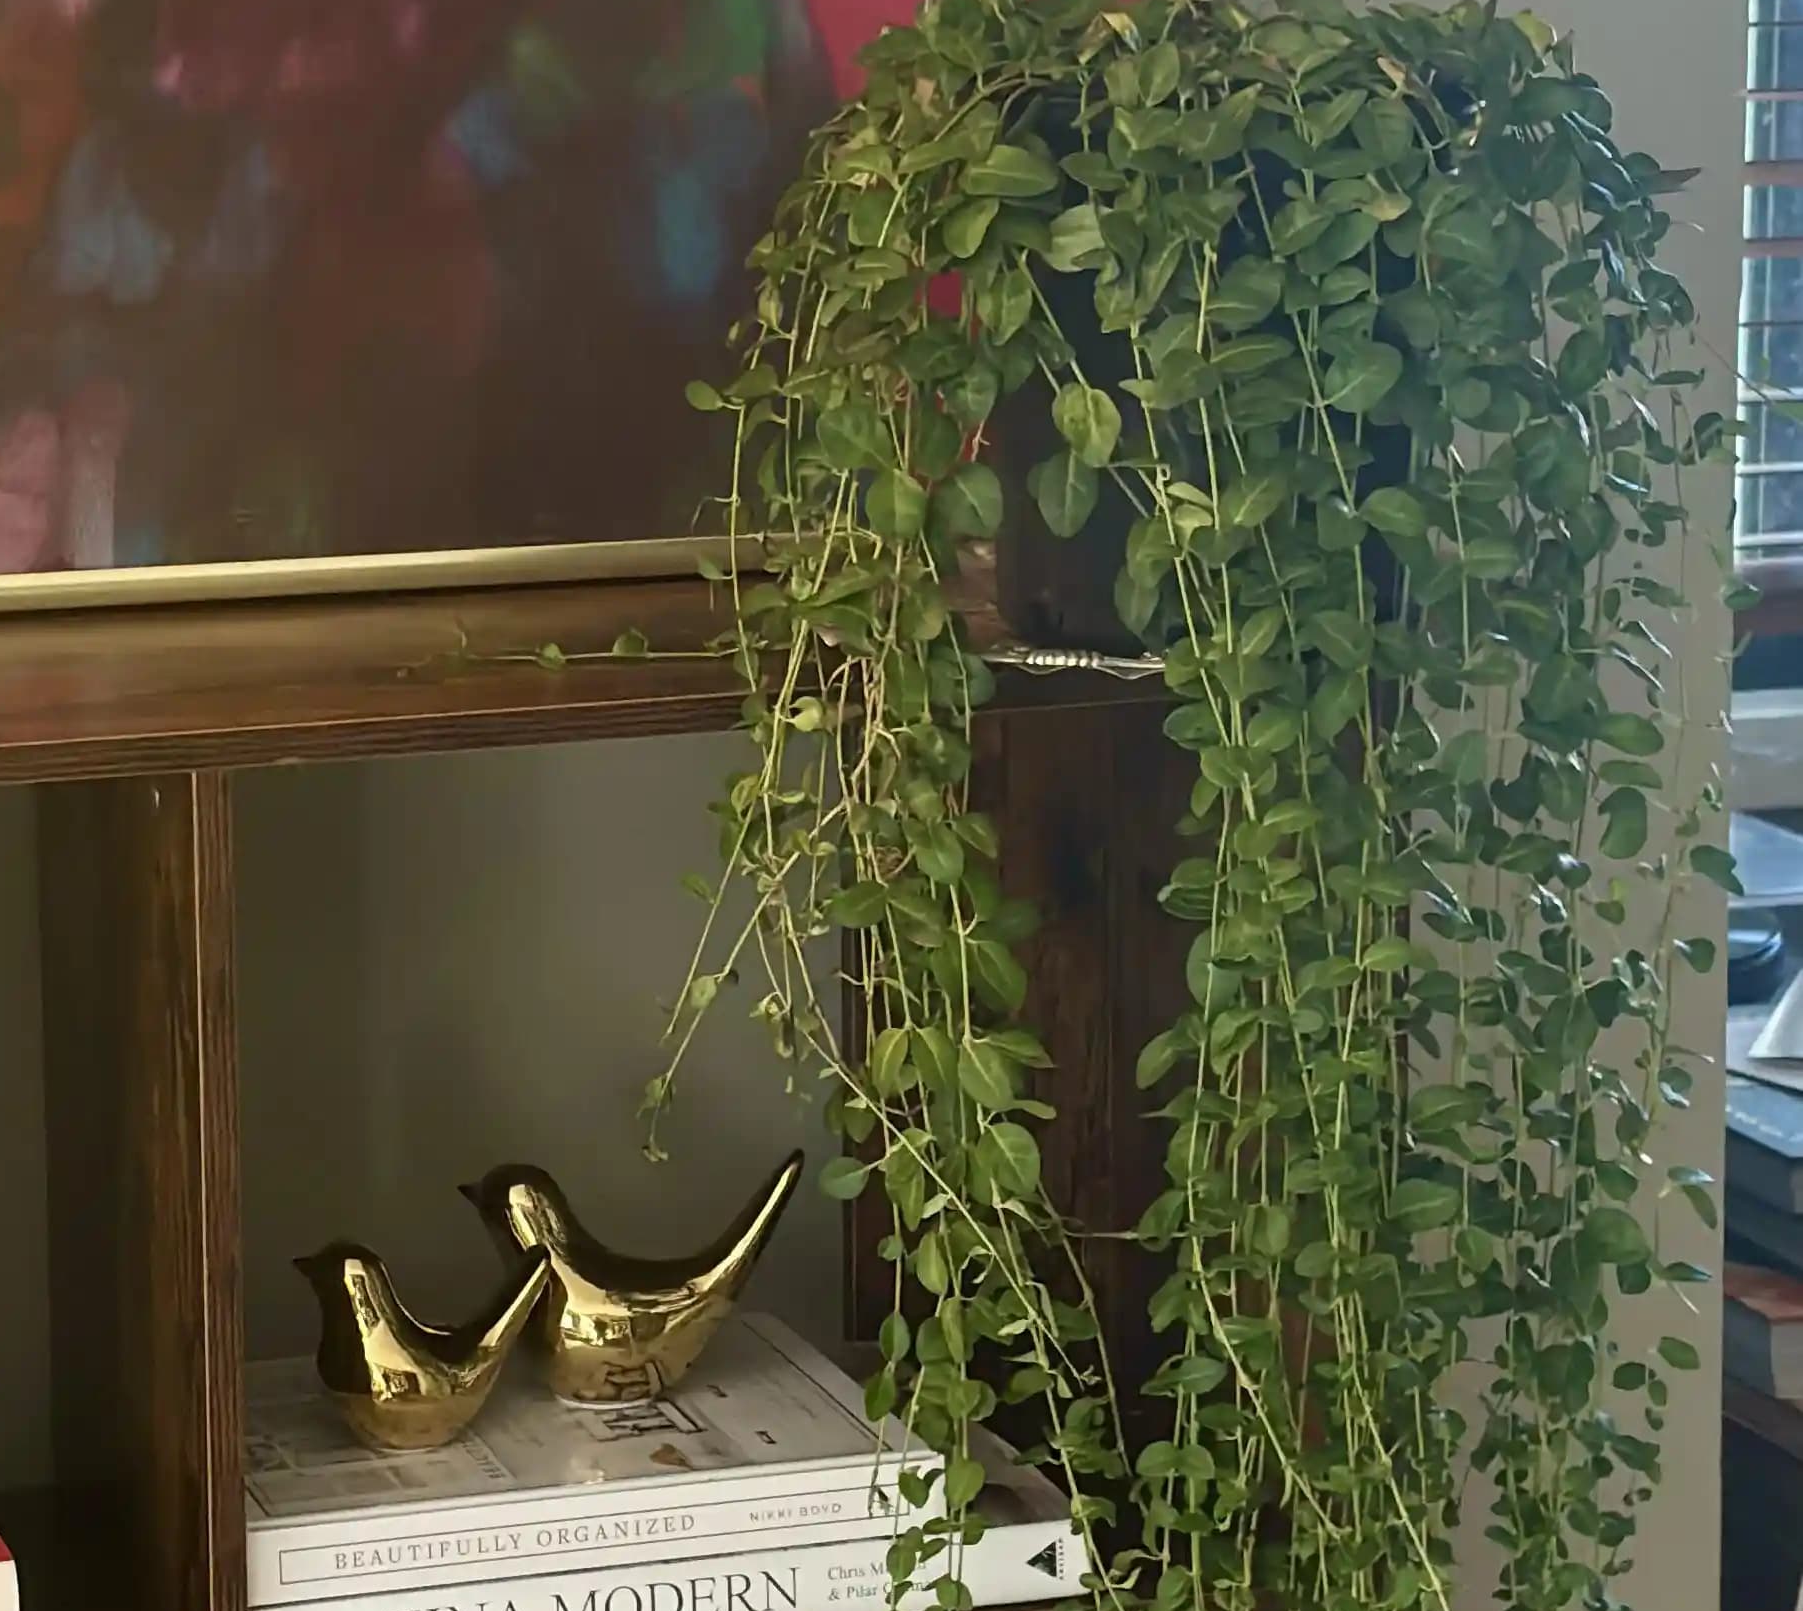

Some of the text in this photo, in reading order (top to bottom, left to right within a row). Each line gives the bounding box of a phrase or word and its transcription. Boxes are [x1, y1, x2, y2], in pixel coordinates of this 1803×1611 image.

[749, 1503, 842, 1522] NIKKI BOYD
[334, 1513, 695, 1570] BEAUTIFULLY ORGANIZED
[827, 1564, 866, 1581] Chris
[847, 1583, 878, 1599] Pilar
